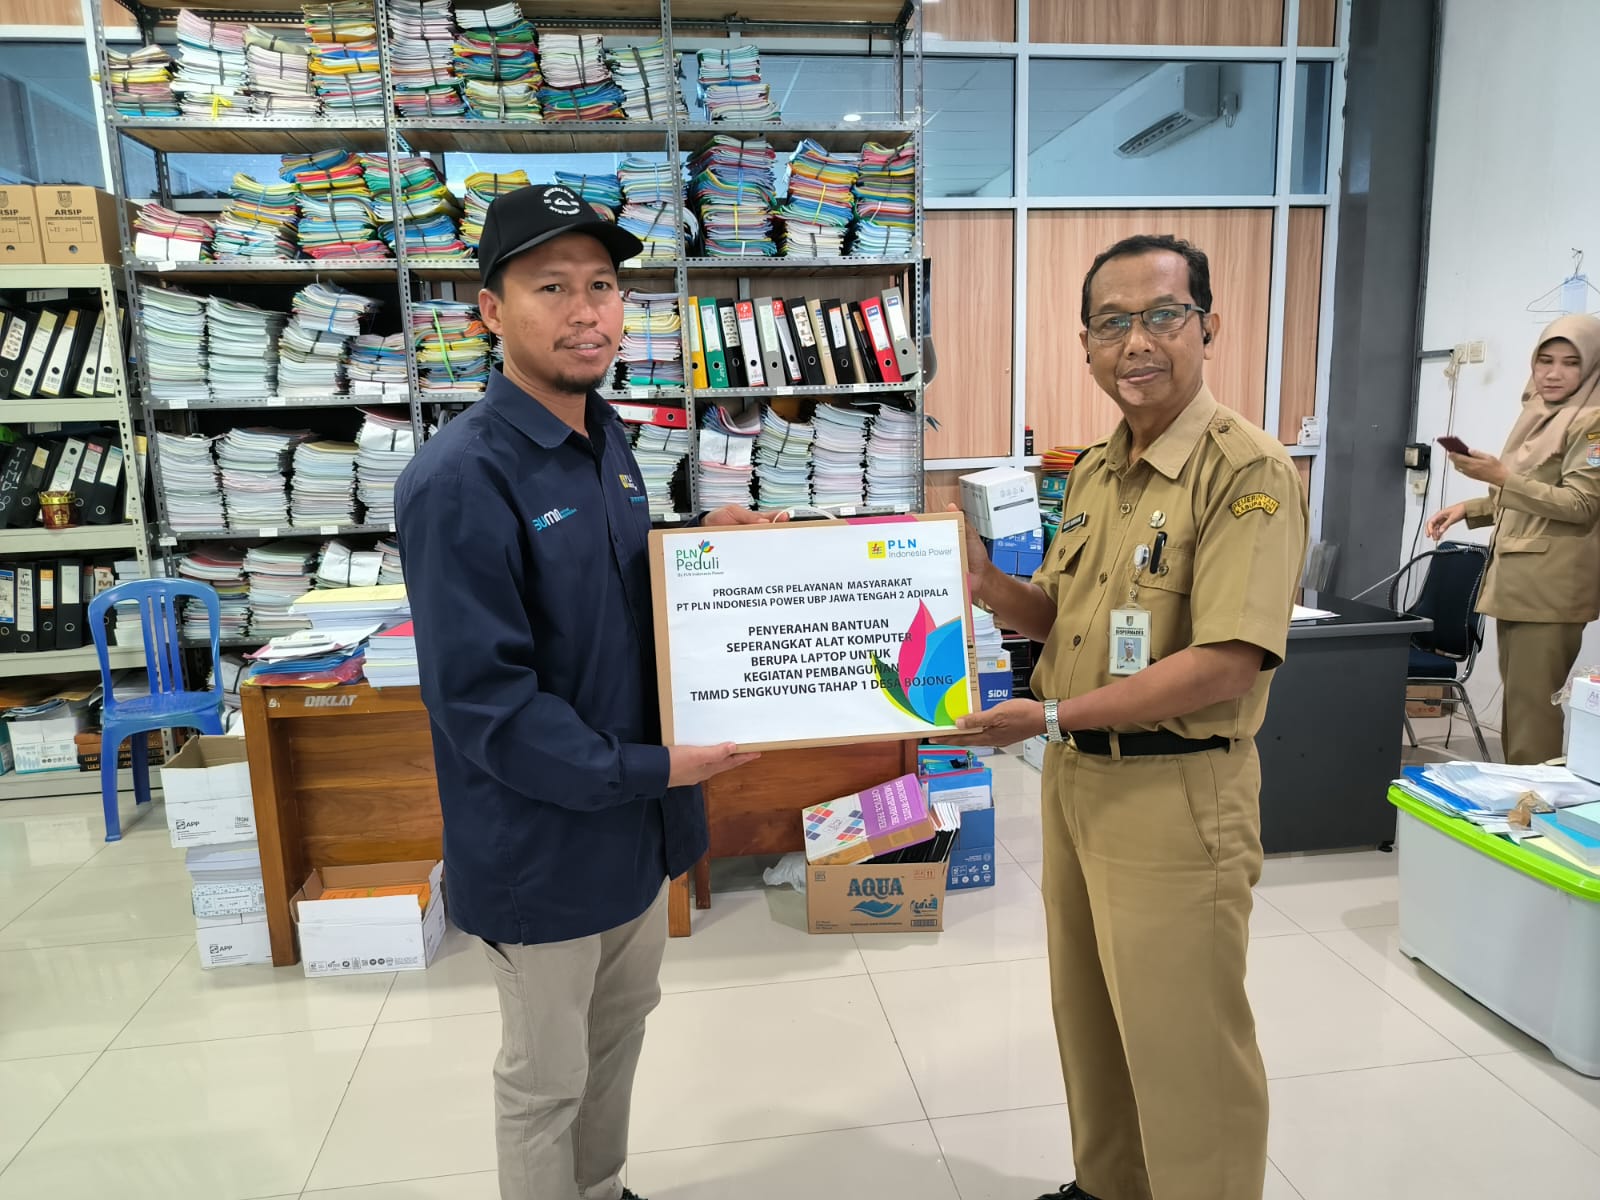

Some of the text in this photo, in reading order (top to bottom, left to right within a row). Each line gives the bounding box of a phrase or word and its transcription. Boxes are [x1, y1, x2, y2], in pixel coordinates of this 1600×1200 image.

[888, 538, 917, 549] PLN
[676, 549, 697, 559] PLN
[888, 548, 952, 558] Indonesia Power
[676, 556, 720, 571] Peduli
[712, 578, 912, 597] PROGRAM CSR PELAYANAN MASYARAKAT
[676, 588, 949, 611] PT PLN INDONESIA POWER UBP JAWA TENGAH 2 ADIPALA
[748, 618, 889, 636] PENYERAHAN BANTUAN
[726, 632, 912, 653] SEPERANGKAT ALAT KOMPUTER
[751, 648, 891, 666] BERUPA LAPTOP UNTUK
[744, 663, 899, 682] KEGIATAN PEMBANGUNAN
[690, 675, 953, 701] TMMD SENGKUYUNG TAHAP 1 DESA BOJONG
[304, 695, 358, 707] DIKLAT
[847, 877, 904, 899] AQUA
